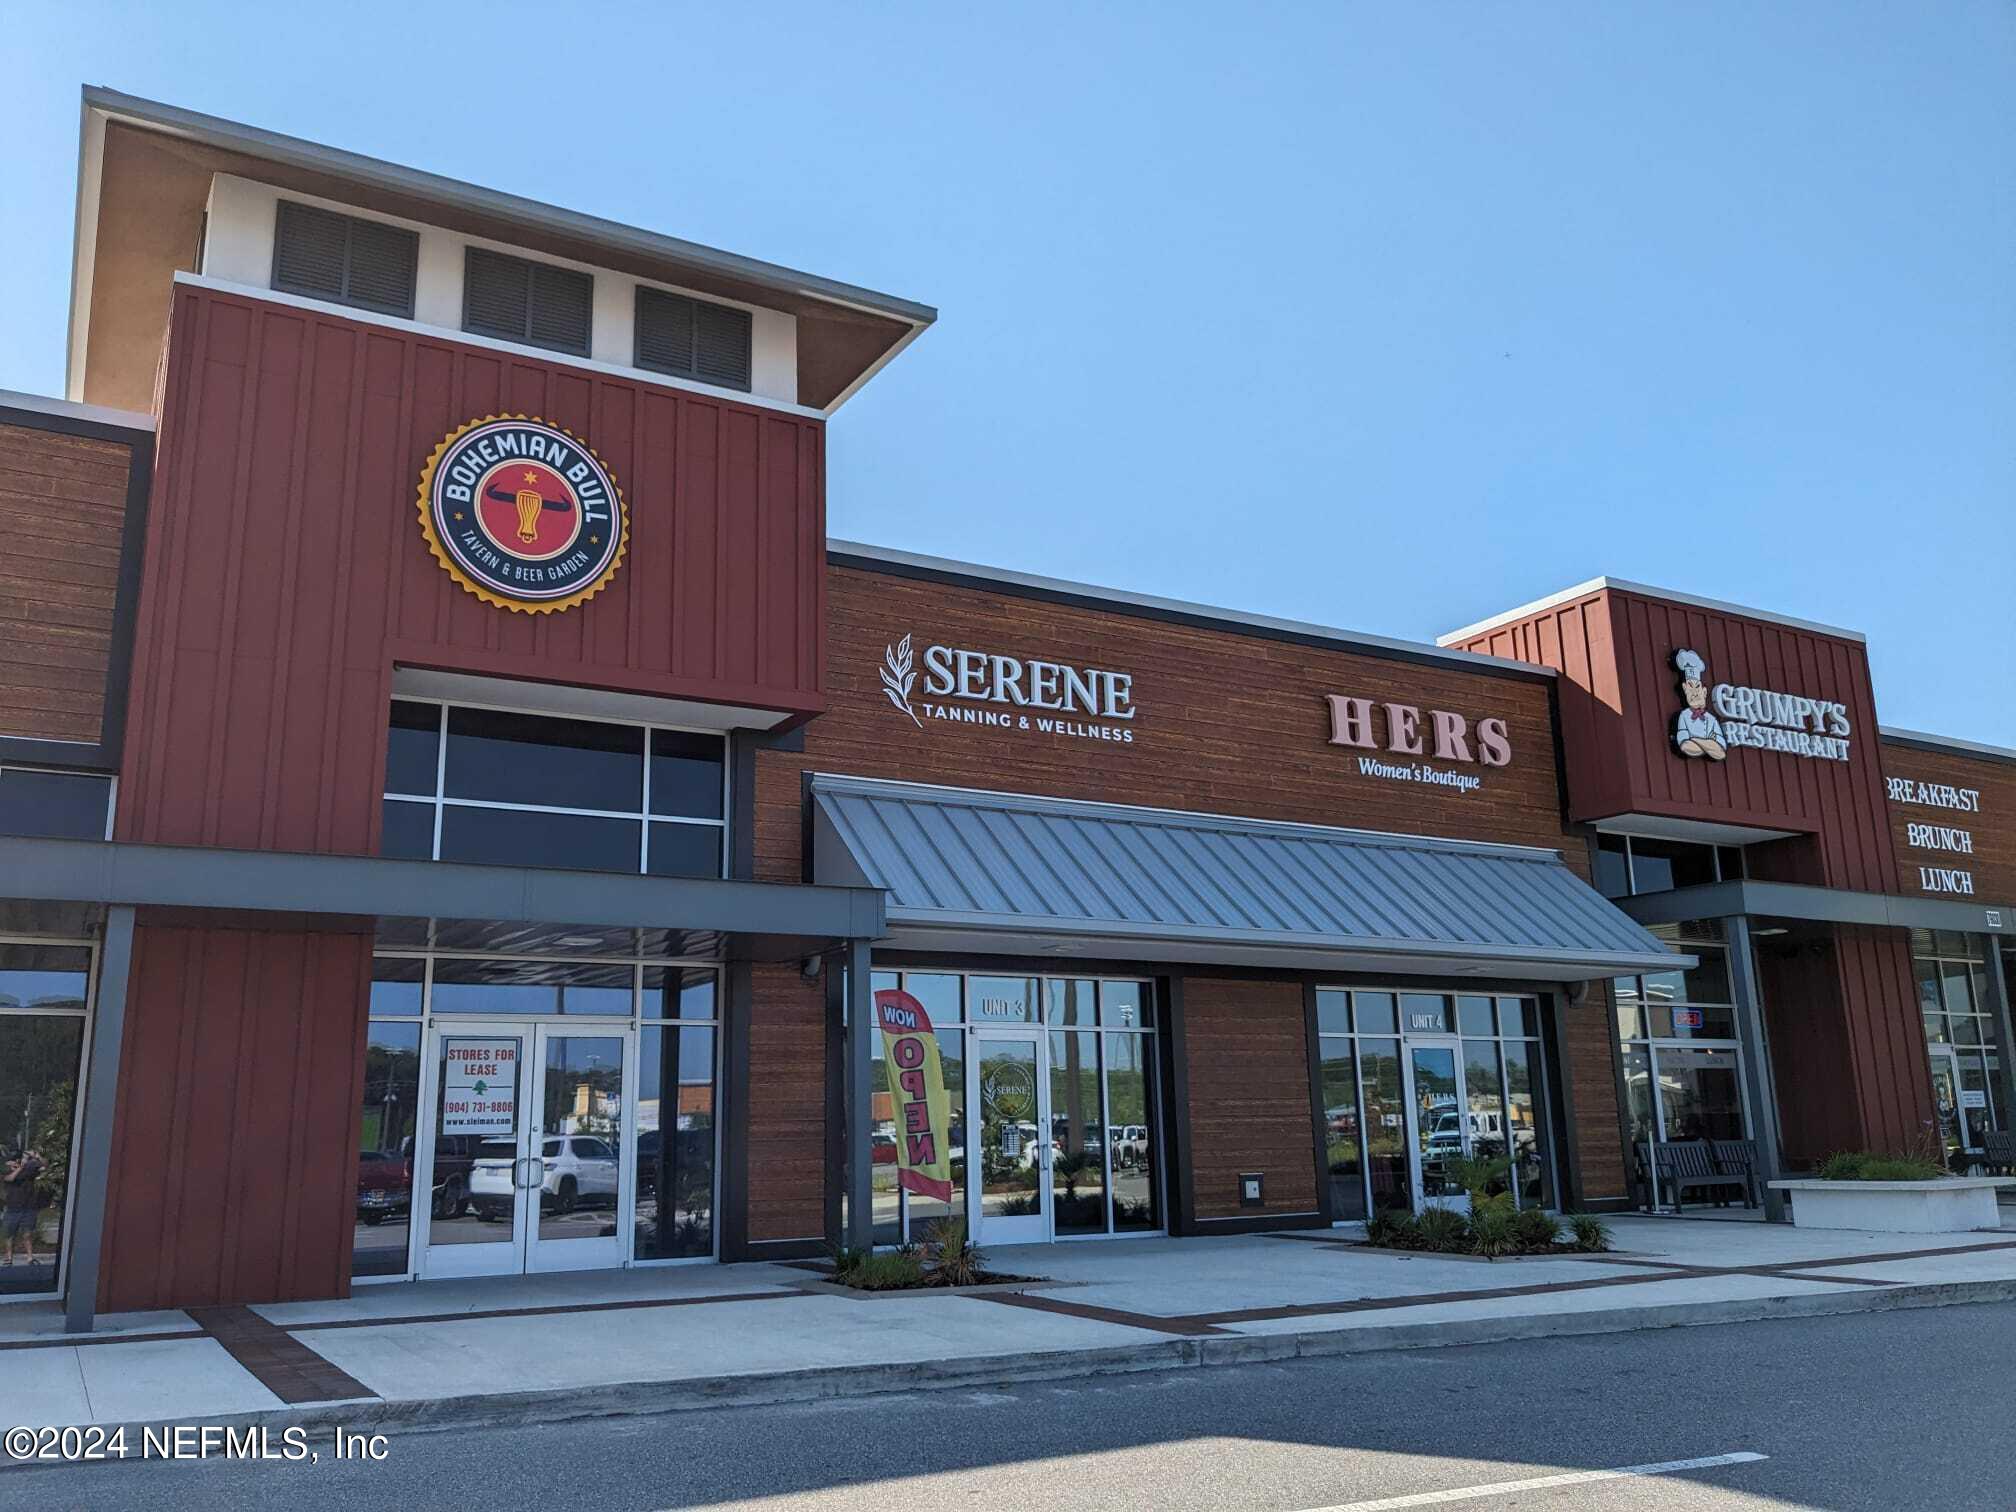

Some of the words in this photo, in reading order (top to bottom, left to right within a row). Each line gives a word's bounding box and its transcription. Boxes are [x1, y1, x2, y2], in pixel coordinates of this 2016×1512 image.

[446, 433, 568, 503] BOHEMIAN
[566, 462, 608, 523] BULL
[461, 529, 499, 569] TAVERN
[502, 563, 510, 576] &
[515, 566, 544, 581] BEER
[548, 551, 590, 580] GARDEN
[923, 645, 1136, 720] SERENE
[923, 704, 1011, 728] TANNING
[1019, 715, 1030, 730] &
[1037, 718, 1134, 743] WELLNESS
[1711, 683, 1851, 737] GRUMPY'S
[1324, 694, 1512, 767] HERS
[1721, 721, 1850, 761] RESTAURANT
[1358, 757, 1421, 782] Women's
[1422, 765, 1480, 793] Boutique
[1907, 823, 1974, 854] BRUNCH
[1919, 867, 1975, 895] LUNCH
[448, 1048, 490, 1061] STORES
[495, 1049, 515, 1060] FOR
[464, 1063, 498, 1076] LEASE
[445, 1101, 469, 1113] (904)
